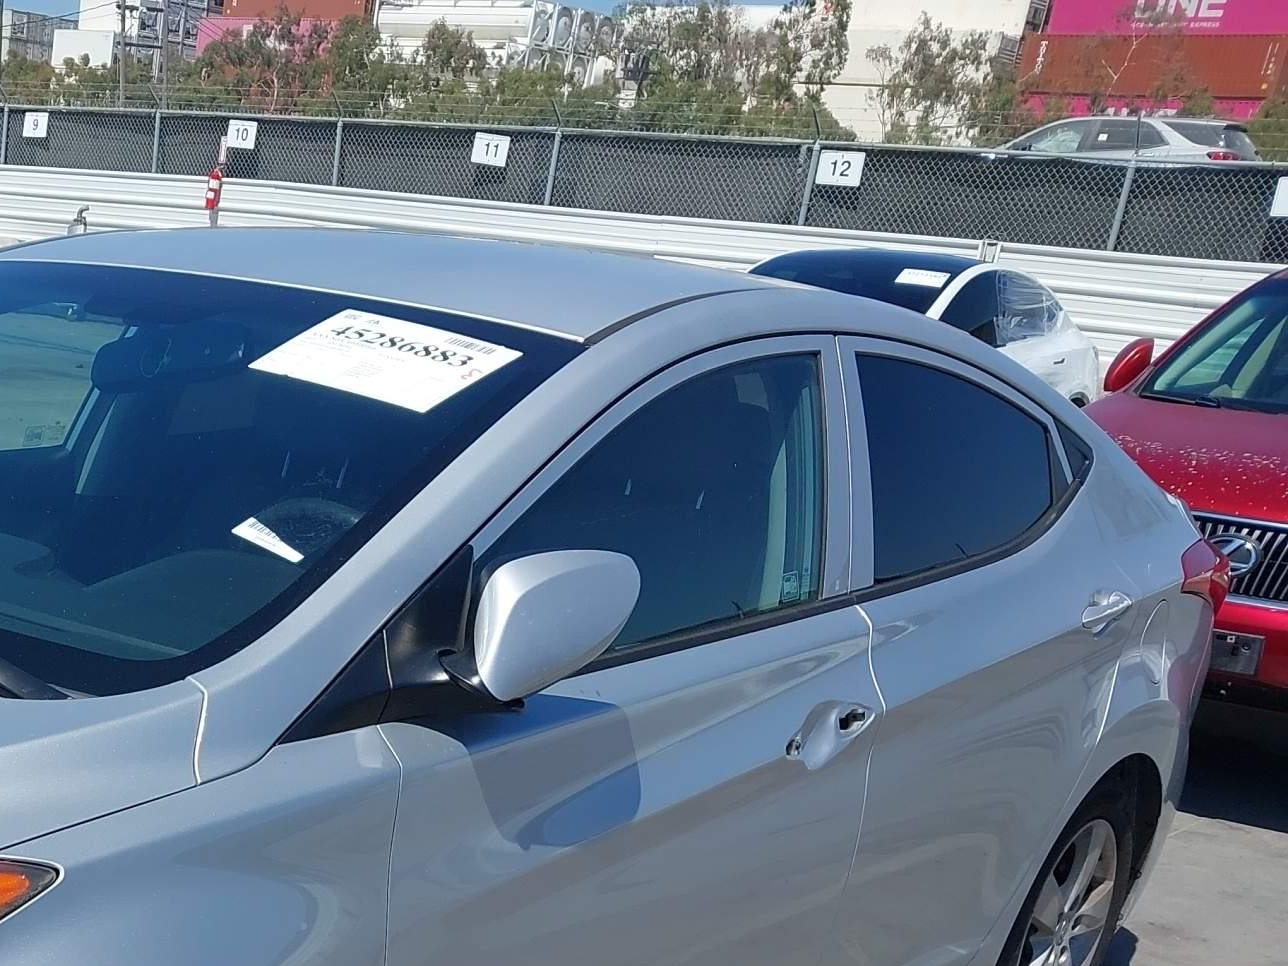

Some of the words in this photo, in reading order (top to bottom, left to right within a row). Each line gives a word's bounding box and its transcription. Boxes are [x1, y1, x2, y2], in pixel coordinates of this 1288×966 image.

[32, 118, 39, 131] 9
[235, 127, 249, 142] 10
[484, 141, 500, 158] 11
[830, 158, 852, 178] 12
[329, 325, 475, 368] 45286883
